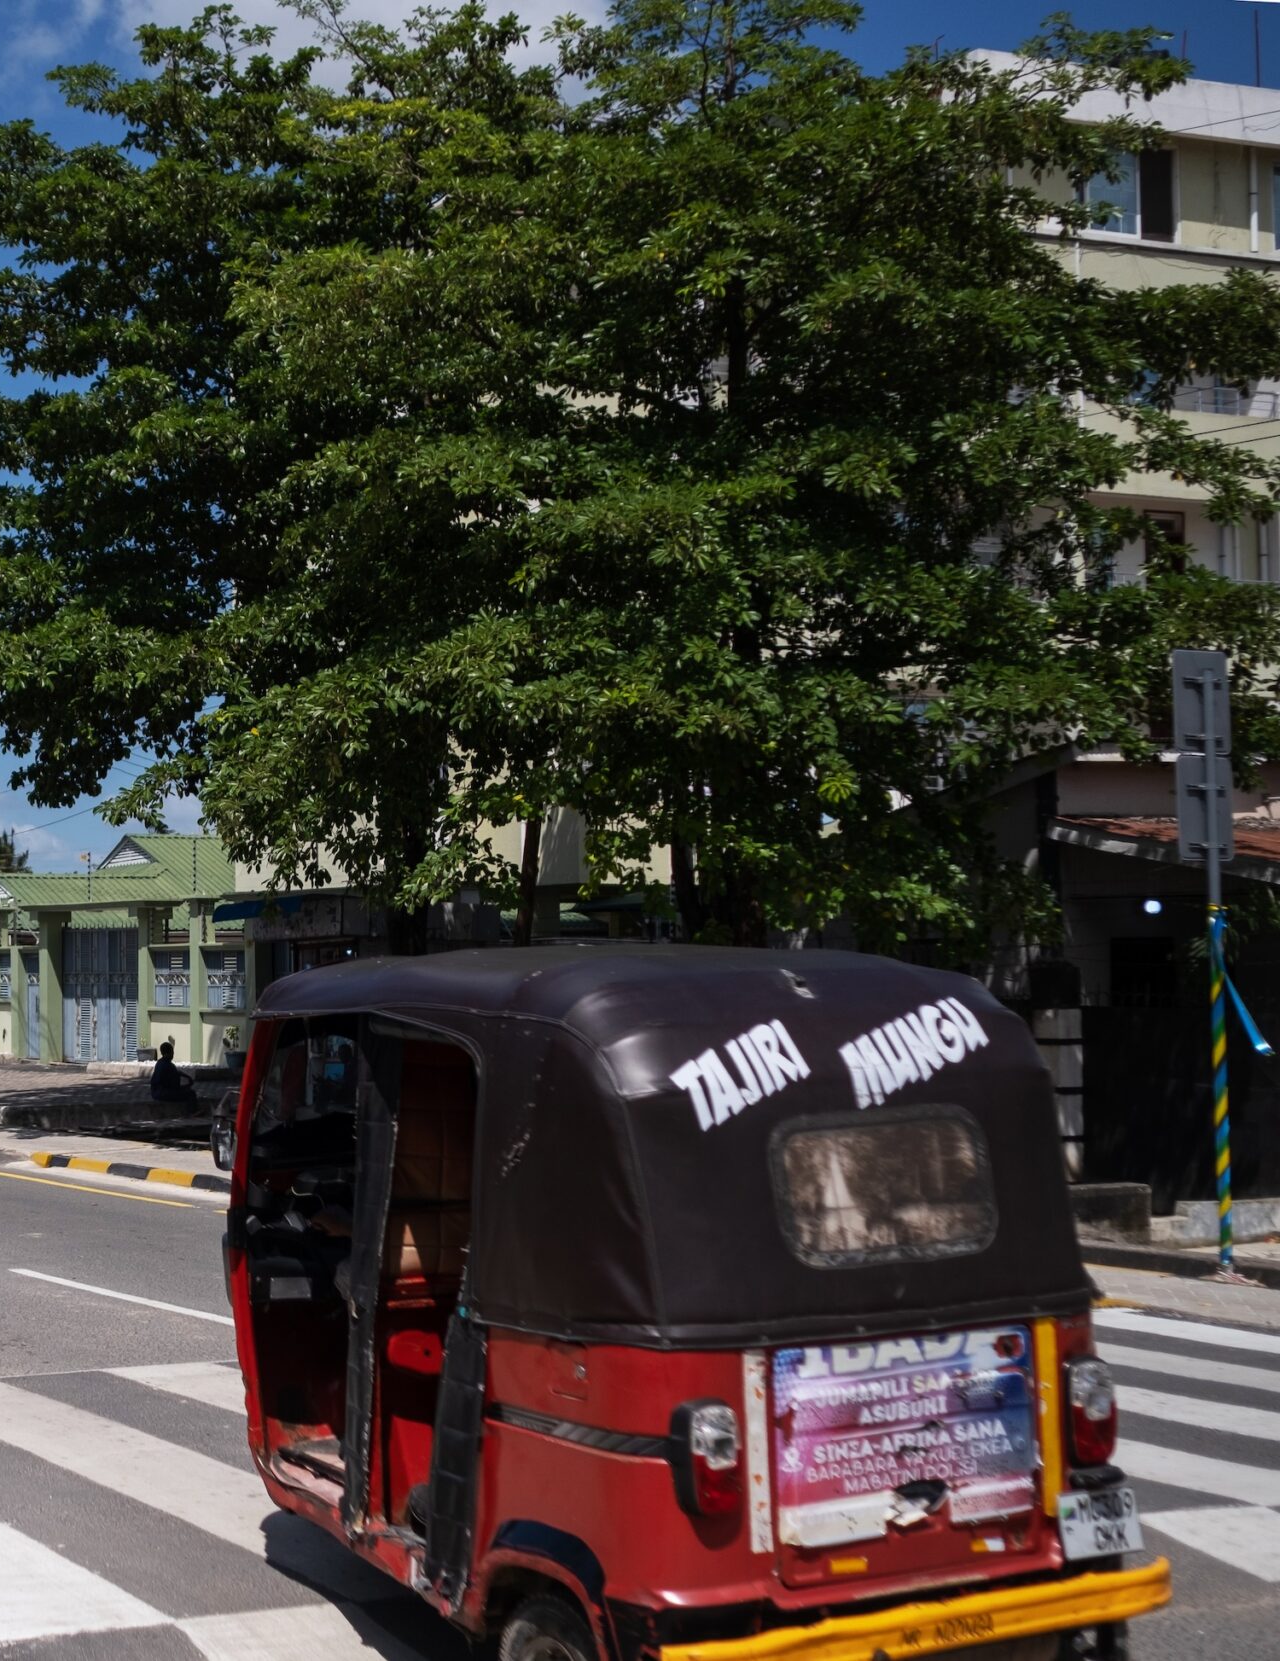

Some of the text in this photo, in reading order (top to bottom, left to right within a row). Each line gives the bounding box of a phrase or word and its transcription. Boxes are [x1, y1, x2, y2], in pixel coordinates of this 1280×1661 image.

[669, 996, 990, 1132] TAJIRI MUNGU
[954, 1418, 1008, 1443] SANA
[805, 1455, 899, 1484] BARABARA
